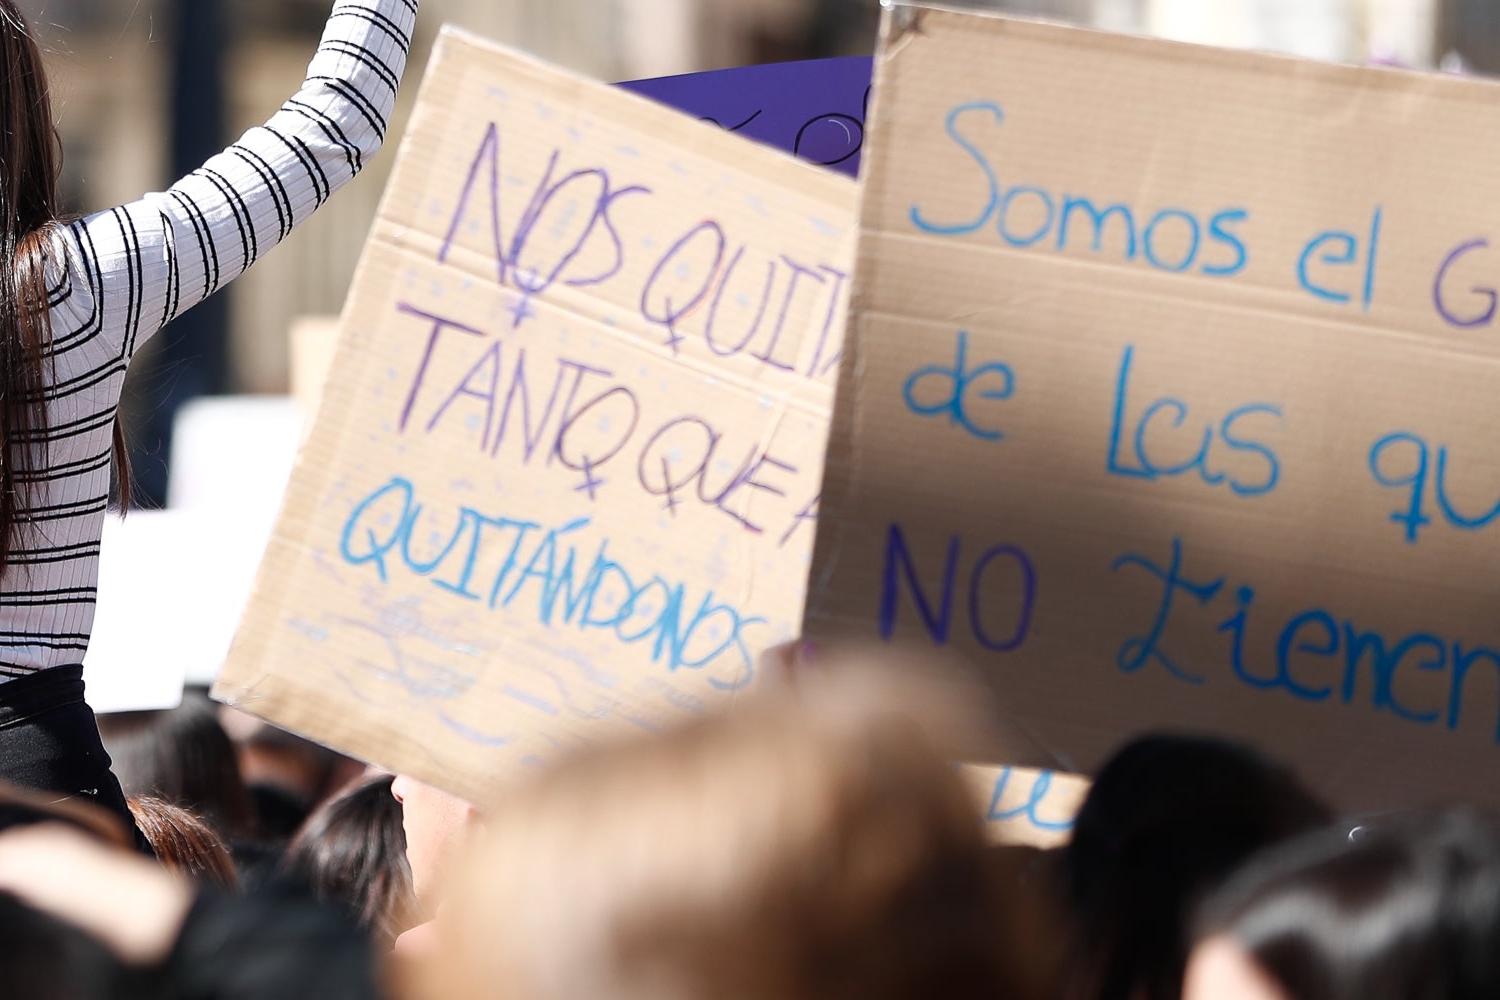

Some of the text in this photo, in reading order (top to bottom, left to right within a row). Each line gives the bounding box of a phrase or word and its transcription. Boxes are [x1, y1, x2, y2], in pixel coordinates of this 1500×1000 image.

[437, 121, 652, 328] NOS
[641, 219, 845, 378] QUIT
[1297, 206, 1382, 310] el
[902, 330, 1015, 443] de
[638, 416, 800, 535] QUE
[338, 477, 768, 691] QUITÁNDONOS
[878, 522, 1035, 651] NO
